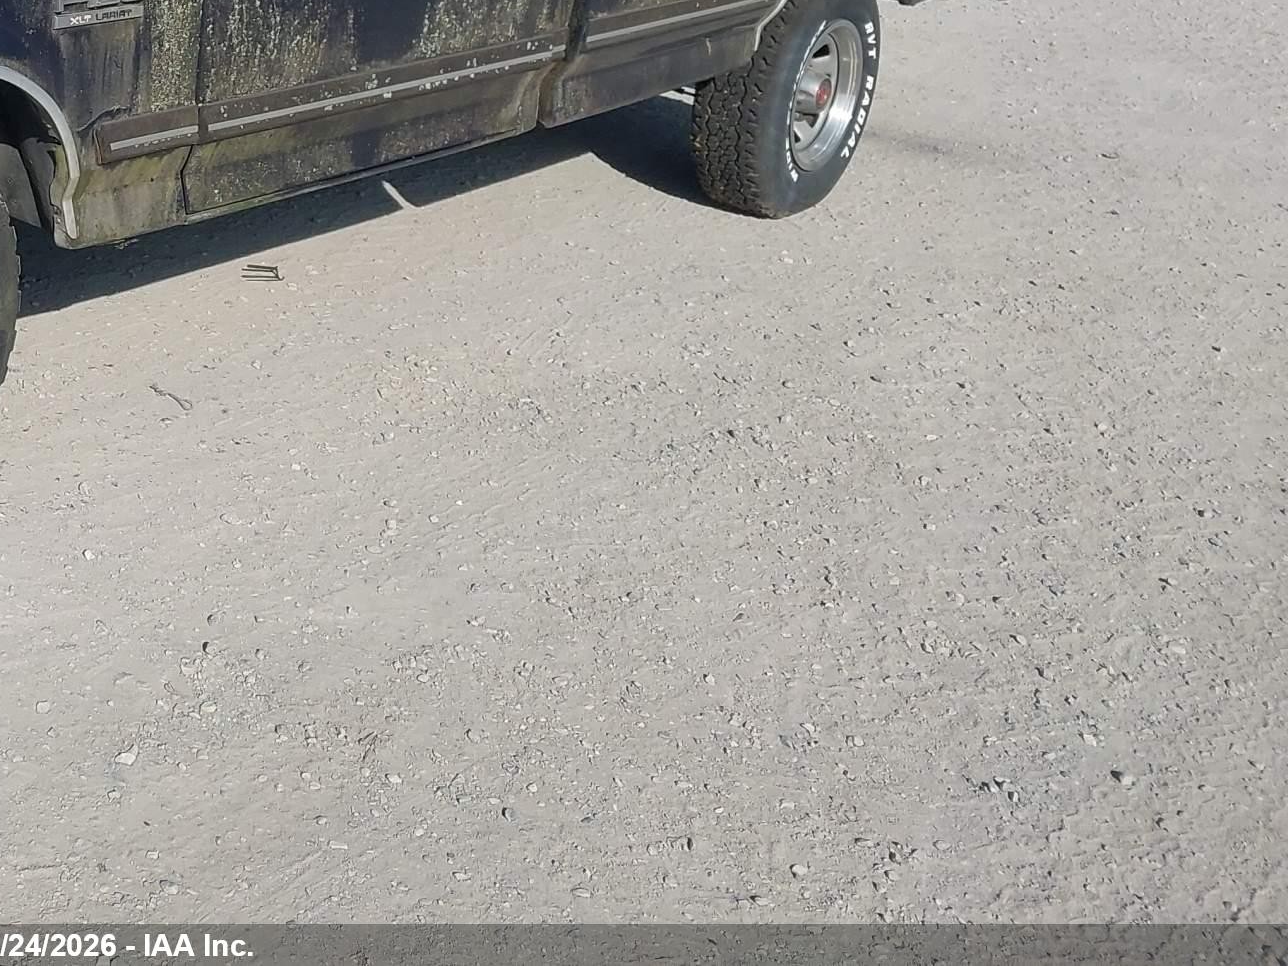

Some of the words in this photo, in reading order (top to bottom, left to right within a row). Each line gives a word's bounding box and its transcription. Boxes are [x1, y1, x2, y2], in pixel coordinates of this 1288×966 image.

[70, 15, 92, 26] XLT
[95, 9, 132, 21] LARIAT
[864, 20, 877, 60] RVT
[840, 74, 875, 159] RADIAL
